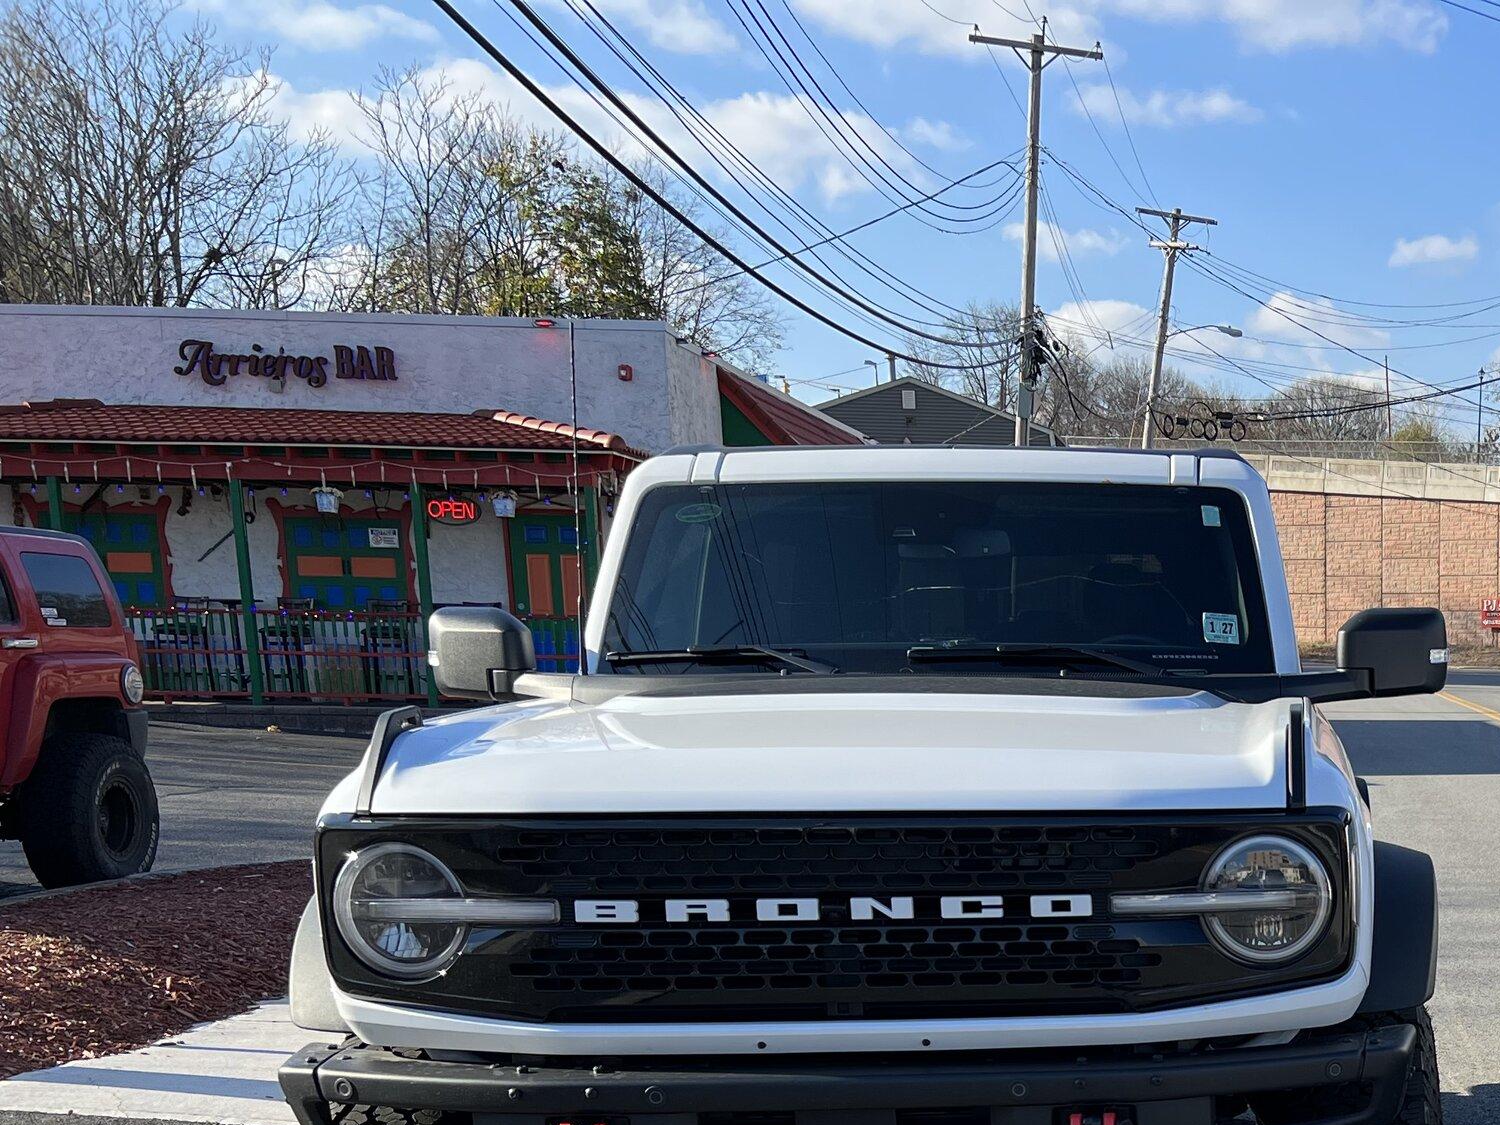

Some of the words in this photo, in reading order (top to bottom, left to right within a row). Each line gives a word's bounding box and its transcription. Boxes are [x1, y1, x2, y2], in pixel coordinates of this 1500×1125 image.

[173, 339, 329, 388] Arrieros
[333, 344, 398, 381] BAR
[428, 500, 475, 519] OPEN
[1209, 621, 1216, 633] 1
[1222, 622, 1234, 634] 27
[574, 894, 1093, 923] BRONCO
